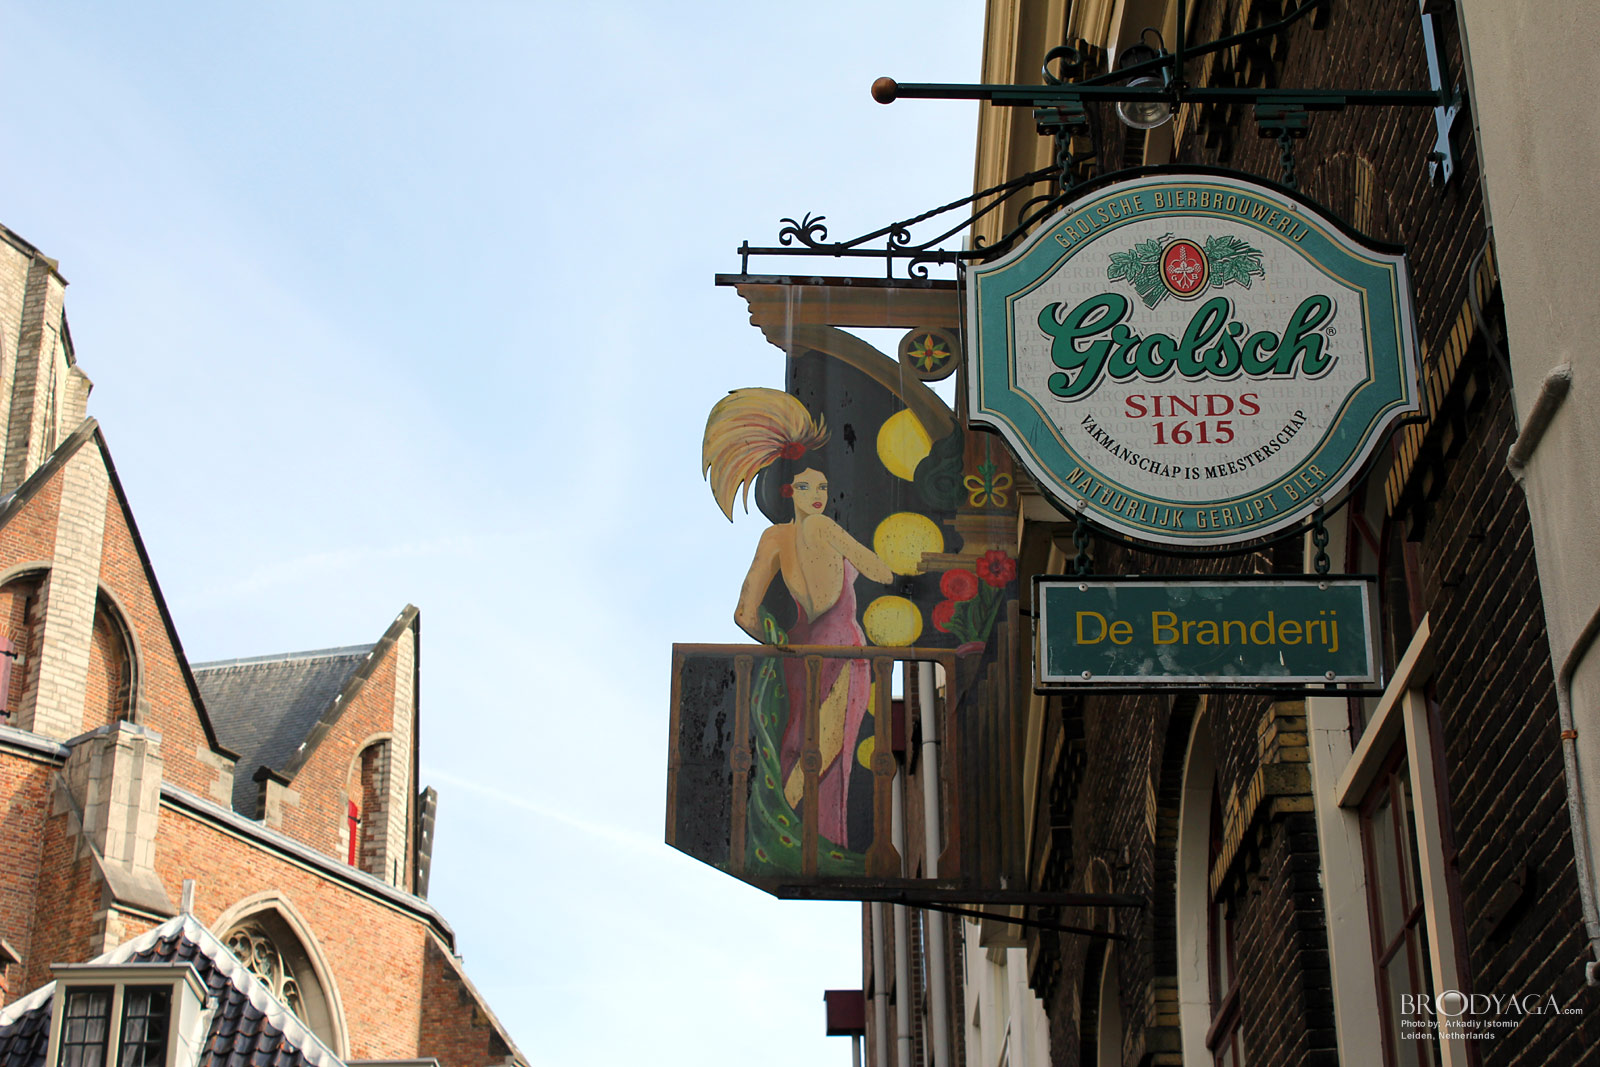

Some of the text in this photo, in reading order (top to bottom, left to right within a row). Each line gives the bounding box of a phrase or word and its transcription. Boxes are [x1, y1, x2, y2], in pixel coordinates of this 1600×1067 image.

[1054, 191, 1309, 248] GROLSCHE BIERBROUWERIJ
[1037, 292, 1332, 397] Grolsch
[1124, 393, 1260, 419] SINDS
[1152, 420, 1235, 445] 1615
[1080, 414, 1181, 479] VAKMANSCHAP
[1185, 467, 1200, 480] IS
[1205, 409, 1307, 479] MEESTERSCHAP
[1065, 464, 1327, 528] NATUURLIJK GERIJPT BIER
[1075, 610, 1339, 653] De Branderij
